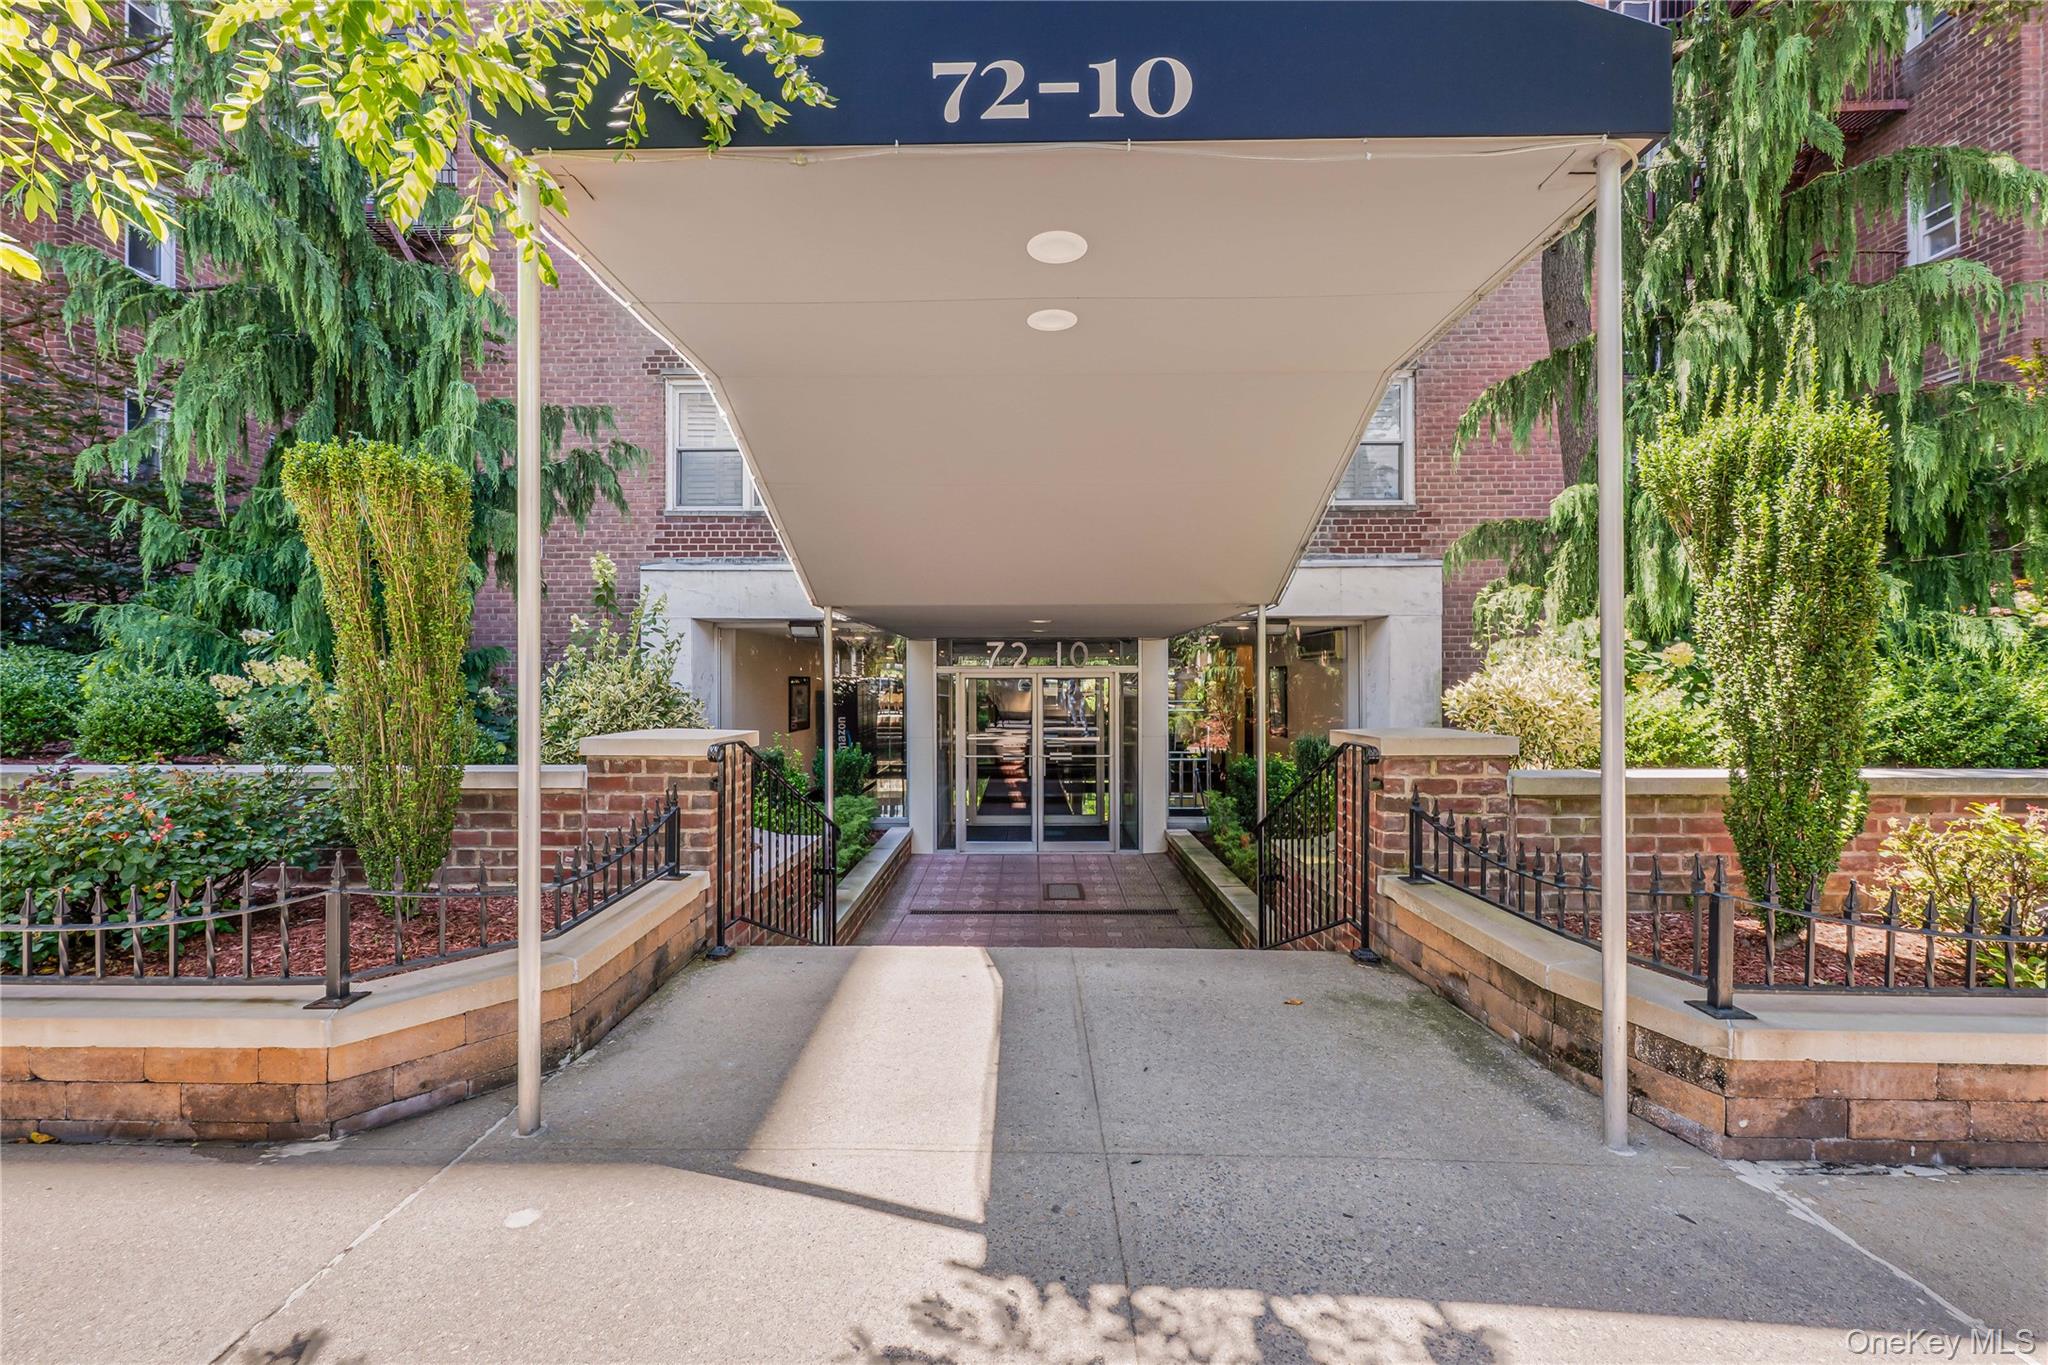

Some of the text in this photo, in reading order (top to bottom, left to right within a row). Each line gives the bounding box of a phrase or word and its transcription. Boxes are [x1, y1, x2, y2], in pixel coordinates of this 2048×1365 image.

[932, 57, 1193, 123] 72-10
[986, 641, 1089, 669] 72 10
[837, 716, 847, 751] mazon
